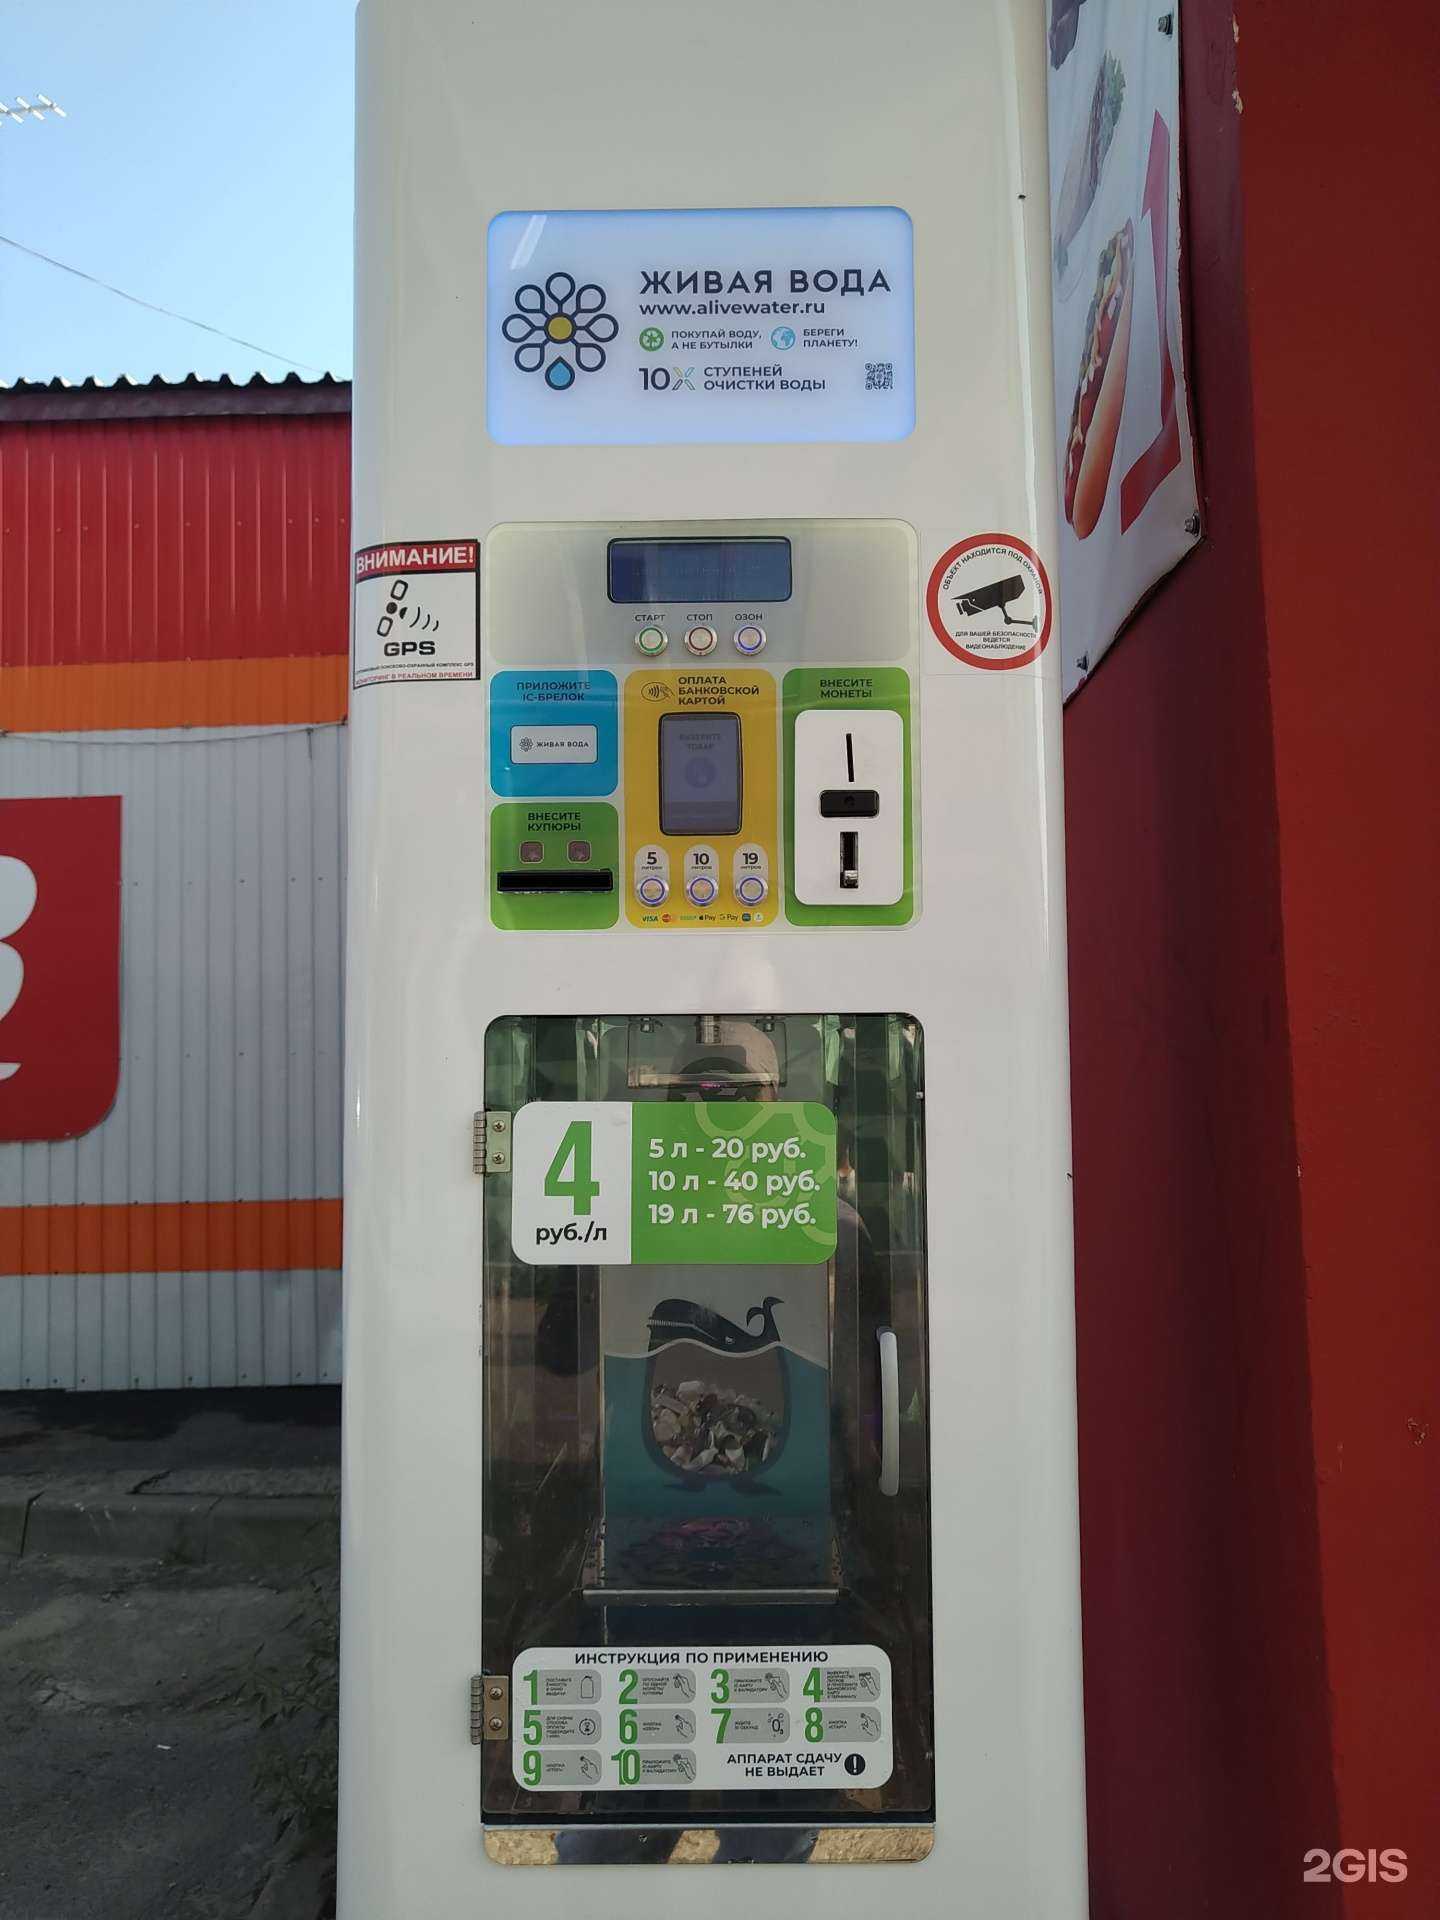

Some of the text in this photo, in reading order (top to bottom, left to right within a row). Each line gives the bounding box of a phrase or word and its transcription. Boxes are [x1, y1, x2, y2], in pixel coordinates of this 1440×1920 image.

[640, 269, 891, 297] ЖИВАЯ ВОДА
[640, 300, 825, 316] www.alivewater.ru
[671, 329, 763, 340] ПОКУПАЙ ВОДУ,
[803, 328, 845, 337] БЕРЕГИ
[671, 340, 753, 350] А НЕ БУТЫЛКИ
[803, 338, 858, 348] ПЛАНЕТУ!
[704, 364, 783, 378] СТУПЕНЕЙ
[704, 379, 825, 392] ОЧИСТКИ ВОДЫ
[356, 546, 474, 574] ВНИМАНИЕ!
[942, 561, 962, 590] ОБЪЕКТ
[961, 547, 1007, 564] НАХОДИТСЯ
[1007, 549, 1024, 564] ПОД
[634, 614, 666, 622] СТАРТ
[686, 613, 713, 622] СТОП
[735, 613, 763, 621] ОЗОН
[384, 641, 436, 656] GPS
[517, 681, 591, 692] ПРИЛОЖИТЕ
[678, 676, 726, 686] ОПЛАТА
[820, 678, 872, 688] ВНЕСИТЕ
[678, 685, 759, 696] БАНКОВСКОЙ
[821, 688, 872, 698] МОНЕТЫ
[678, 695, 726, 705] КАРТОЙ
[528, 812, 581, 821] ВНЕСИТЕ
[528, 821, 581, 832] КУПЮРЫ
[646, 852, 658, 865] 5
[693, 853, 710, 865] 10
[742, 852, 759, 865] 19
[649, 1139, 665, 1158] 5
[670, 1142, 688, 1158] л
[711, 1138, 744, 1159] 20
[751, 1137, 806, 1163] руб.
[544, 1120, 600, 1216] 4
[648, 1171, 676, 1191] 10
[681, 1173, 699, 1191] л
[723, 1171, 758, 1192] 40
[766, 1169, 821, 1196] руб.
[648, 1204, 675, 1225] 19
[681, 1207, 698, 1225] л
[722, 1204, 755, 1225] 76
[761, 1203, 817, 1229] руб.
[536, 1221, 607, 1245] руб./л
[575, 1651, 829, 1666] ИНСТРУКЦИЯ ПО ПРИМЕНЕНИЮ
[523, 1670, 538, 1705] 1
[619, 1669, 638, 1704] 2
[711, 1668, 730, 1703] 3
[803, 1667, 823, 1702] 4
[524, 1710, 542, 1745] 5
[619, 1709, 638, 1744] 6
[711, 1708, 731, 1744] 7
[805, 1707, 824, 1743] 8
[727, 1752, 842, 1766] АППАРАТ СДАЧУ
[524, 1751, 541, 1785] 9
[611, 1749, 640, 1785] 10
[745, 1765, 825, 1778] НЕ ВЫДАЕТ
